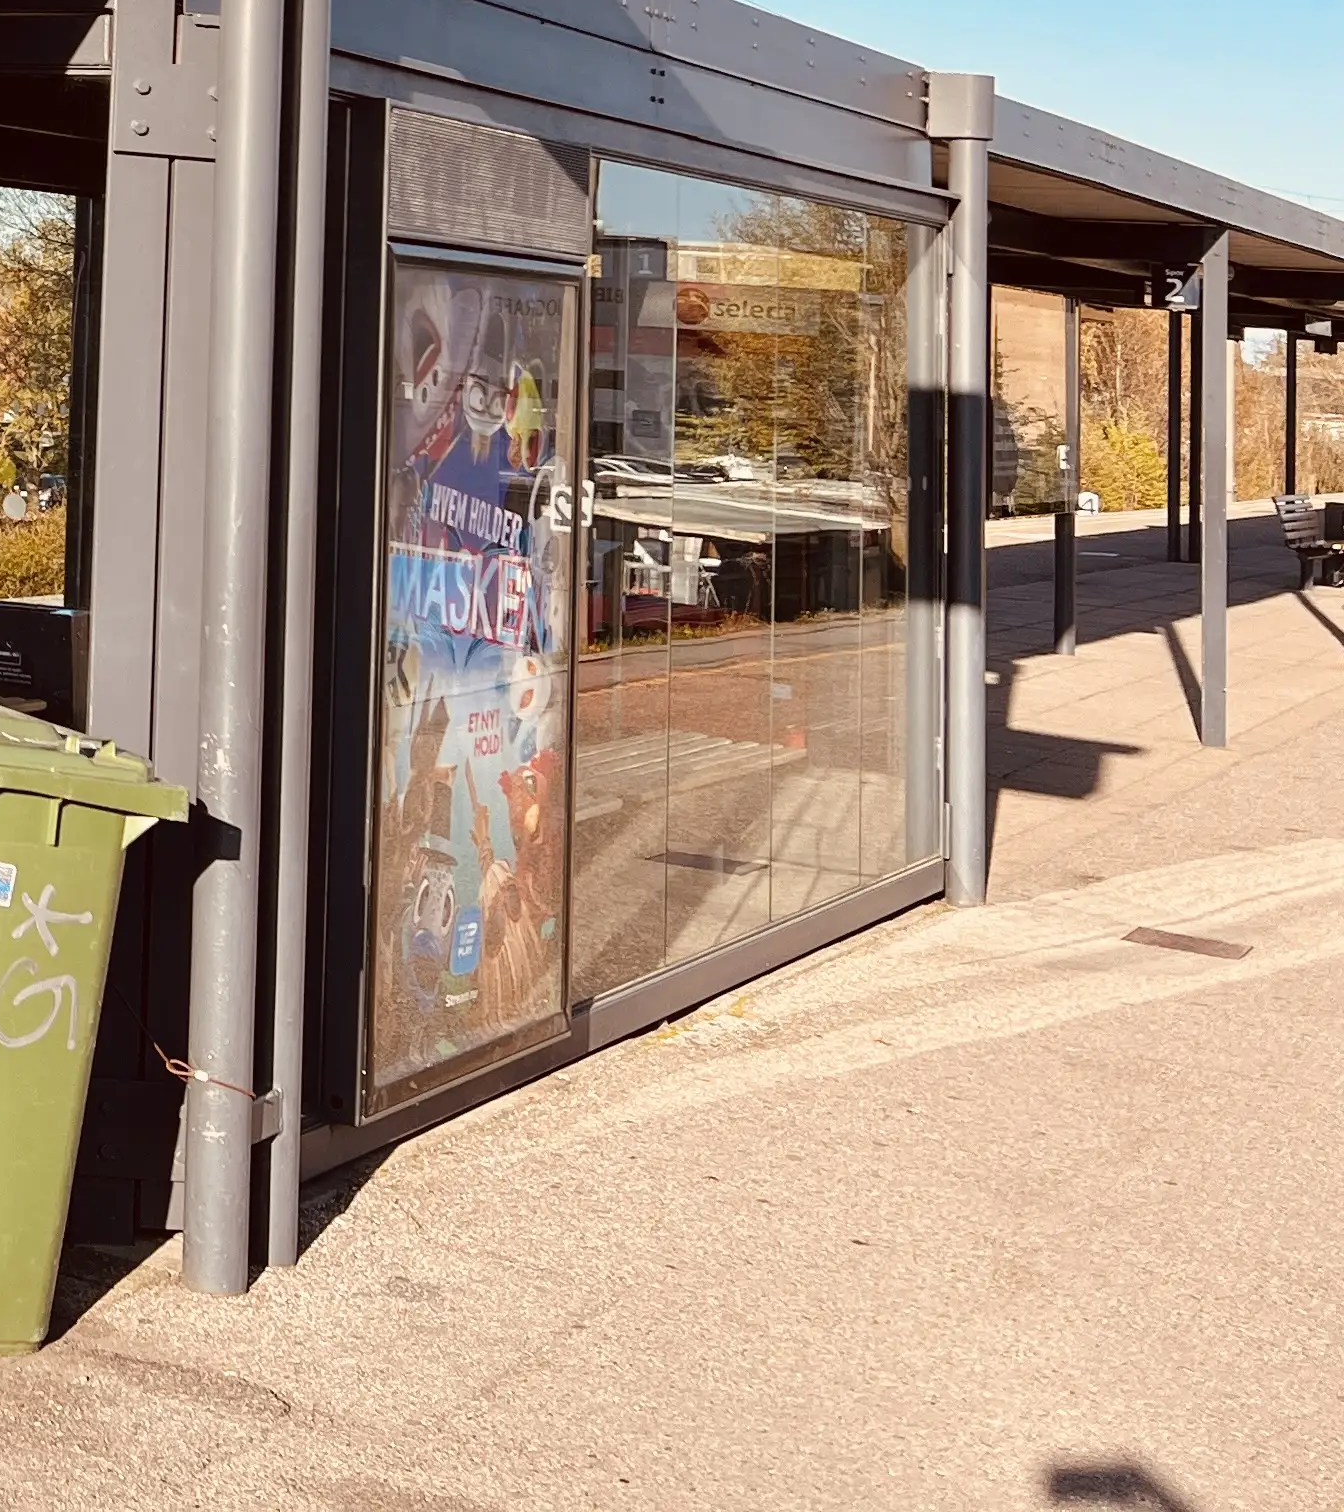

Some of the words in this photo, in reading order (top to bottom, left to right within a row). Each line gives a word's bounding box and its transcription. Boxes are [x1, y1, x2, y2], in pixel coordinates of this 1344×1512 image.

[1164, 278, 1185, 303] 2
[430, 483, 469, 531] HVEM
[468, 496, 523, 556] HOLDER
[390, 528, 548, 655] MASKEN
[468, 712, 480, 733] ET
[481, 708, 500, 731] NYT
